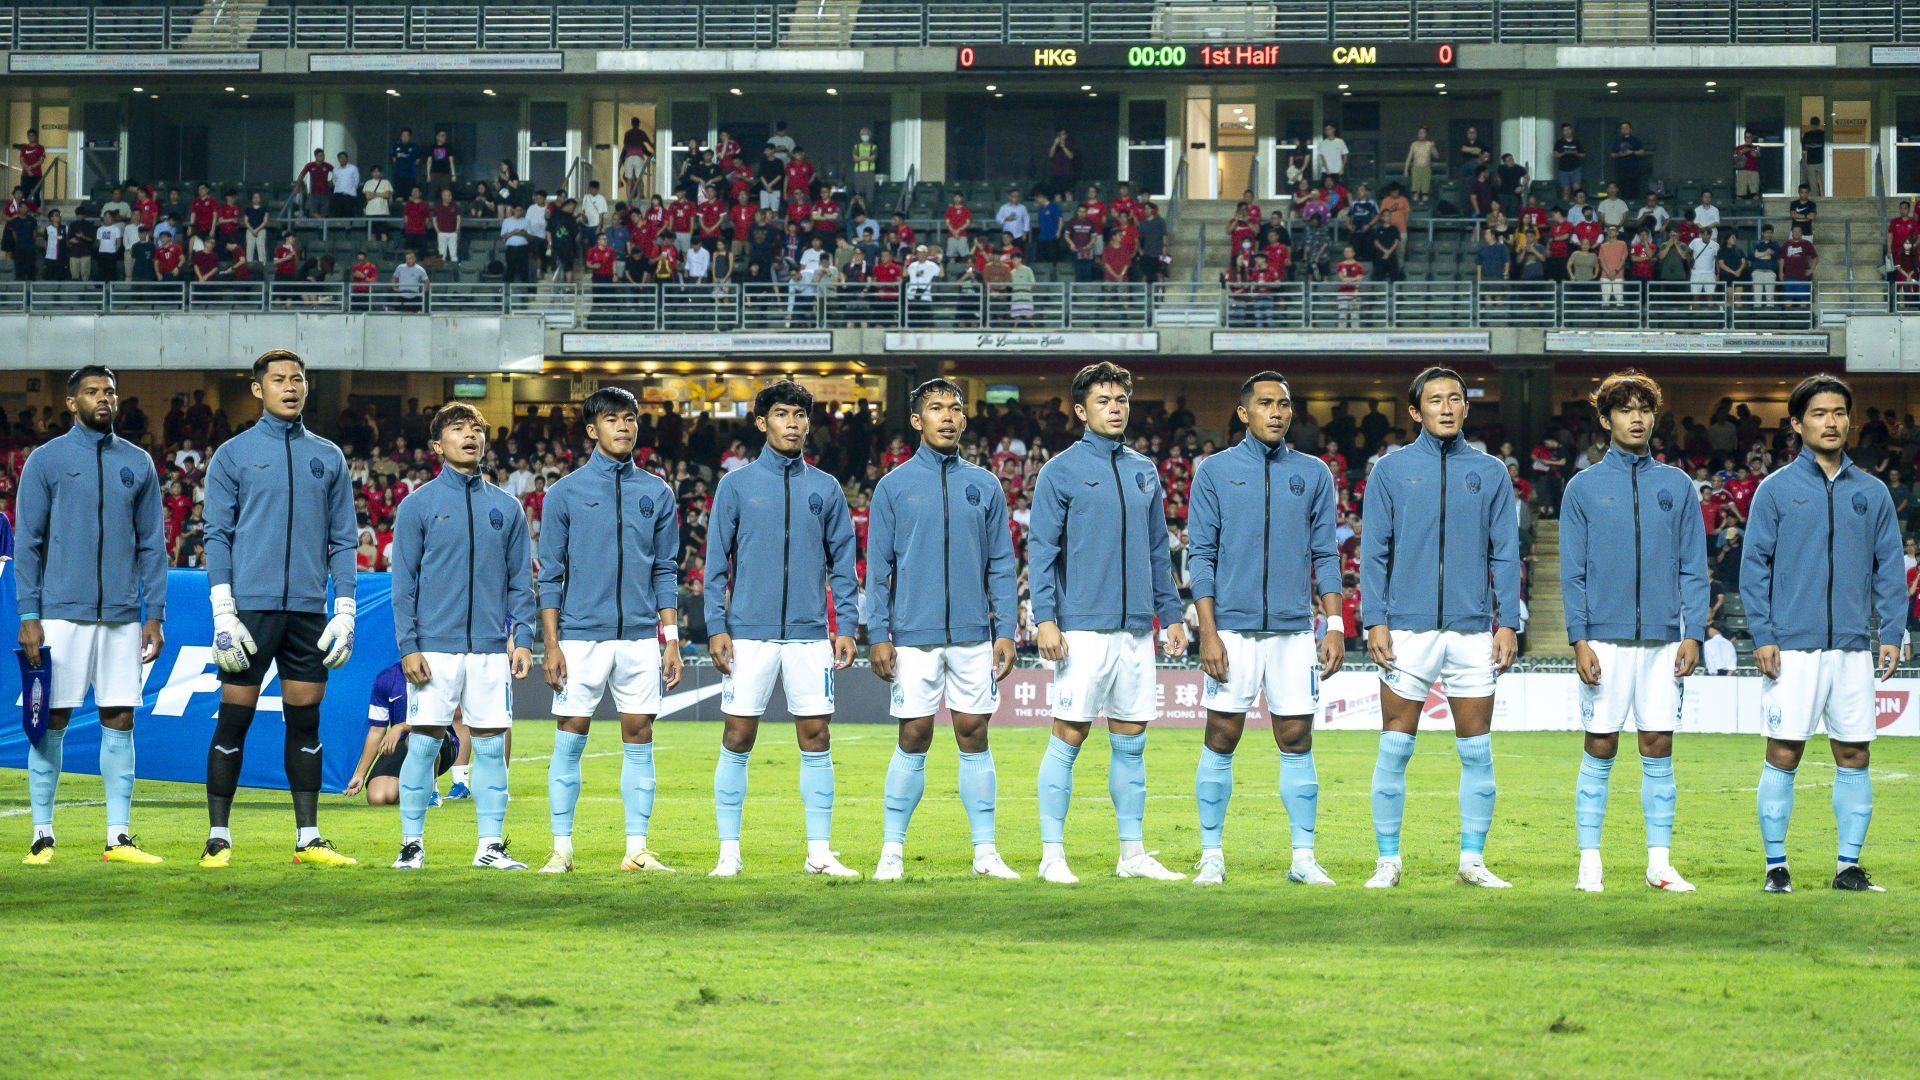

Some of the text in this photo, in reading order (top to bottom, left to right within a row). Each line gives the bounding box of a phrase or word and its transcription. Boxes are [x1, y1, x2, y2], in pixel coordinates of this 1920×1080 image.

[960, 44, 1452, 66] 0 HKG 00:00 1st Half CAM 0
[1014, 708, 1033, 717] THE
[1166, 709, 1196, 719] HONG
